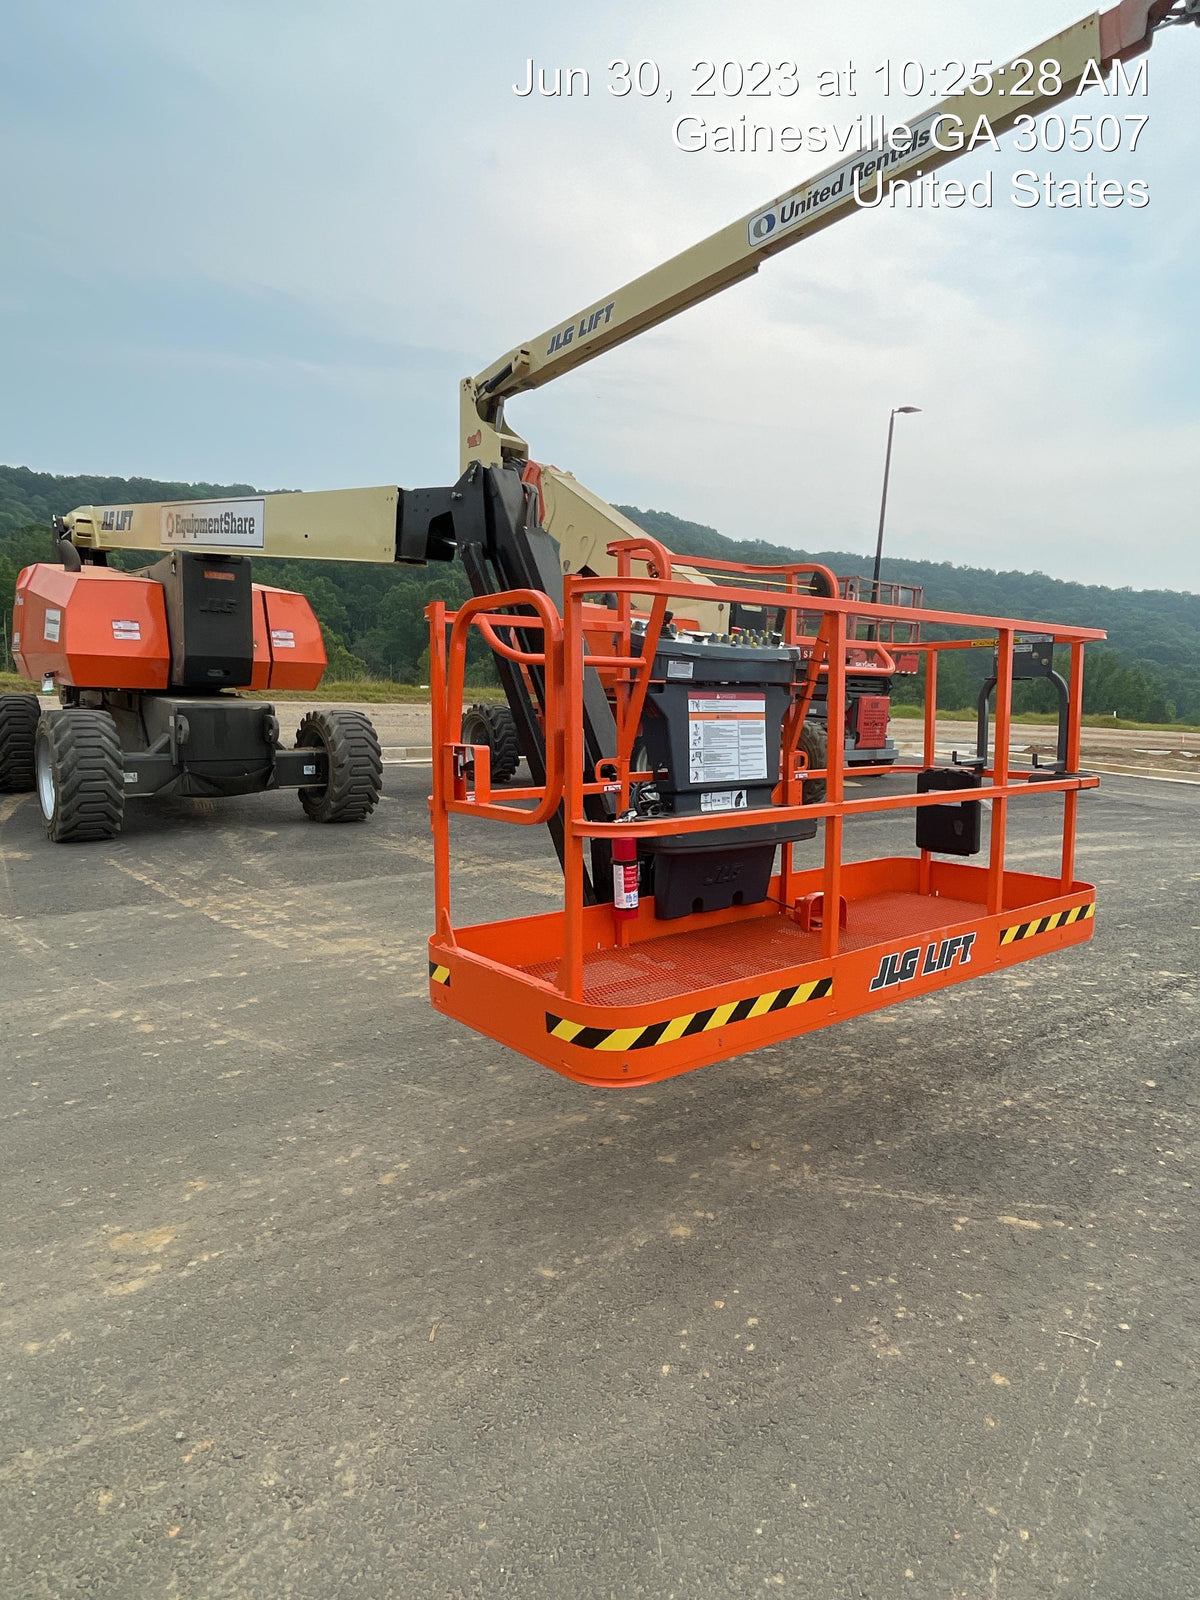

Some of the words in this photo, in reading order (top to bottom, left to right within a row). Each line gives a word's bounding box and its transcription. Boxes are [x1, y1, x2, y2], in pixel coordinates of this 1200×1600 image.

[780, 172, 845, 224] United
[850, 128, 931, 186] Rentals
[546, 325, 575, 356] JLG
[578, 302, 615, 338] LIFT
[101, 511, 114, 531] JLG
[115, 510, 133, 531] LIFT
[175, 511, 255, 539] EquipmentShare
[868, 946, 921, 993] JLG
[921, 931, 977, 977] LIFT
